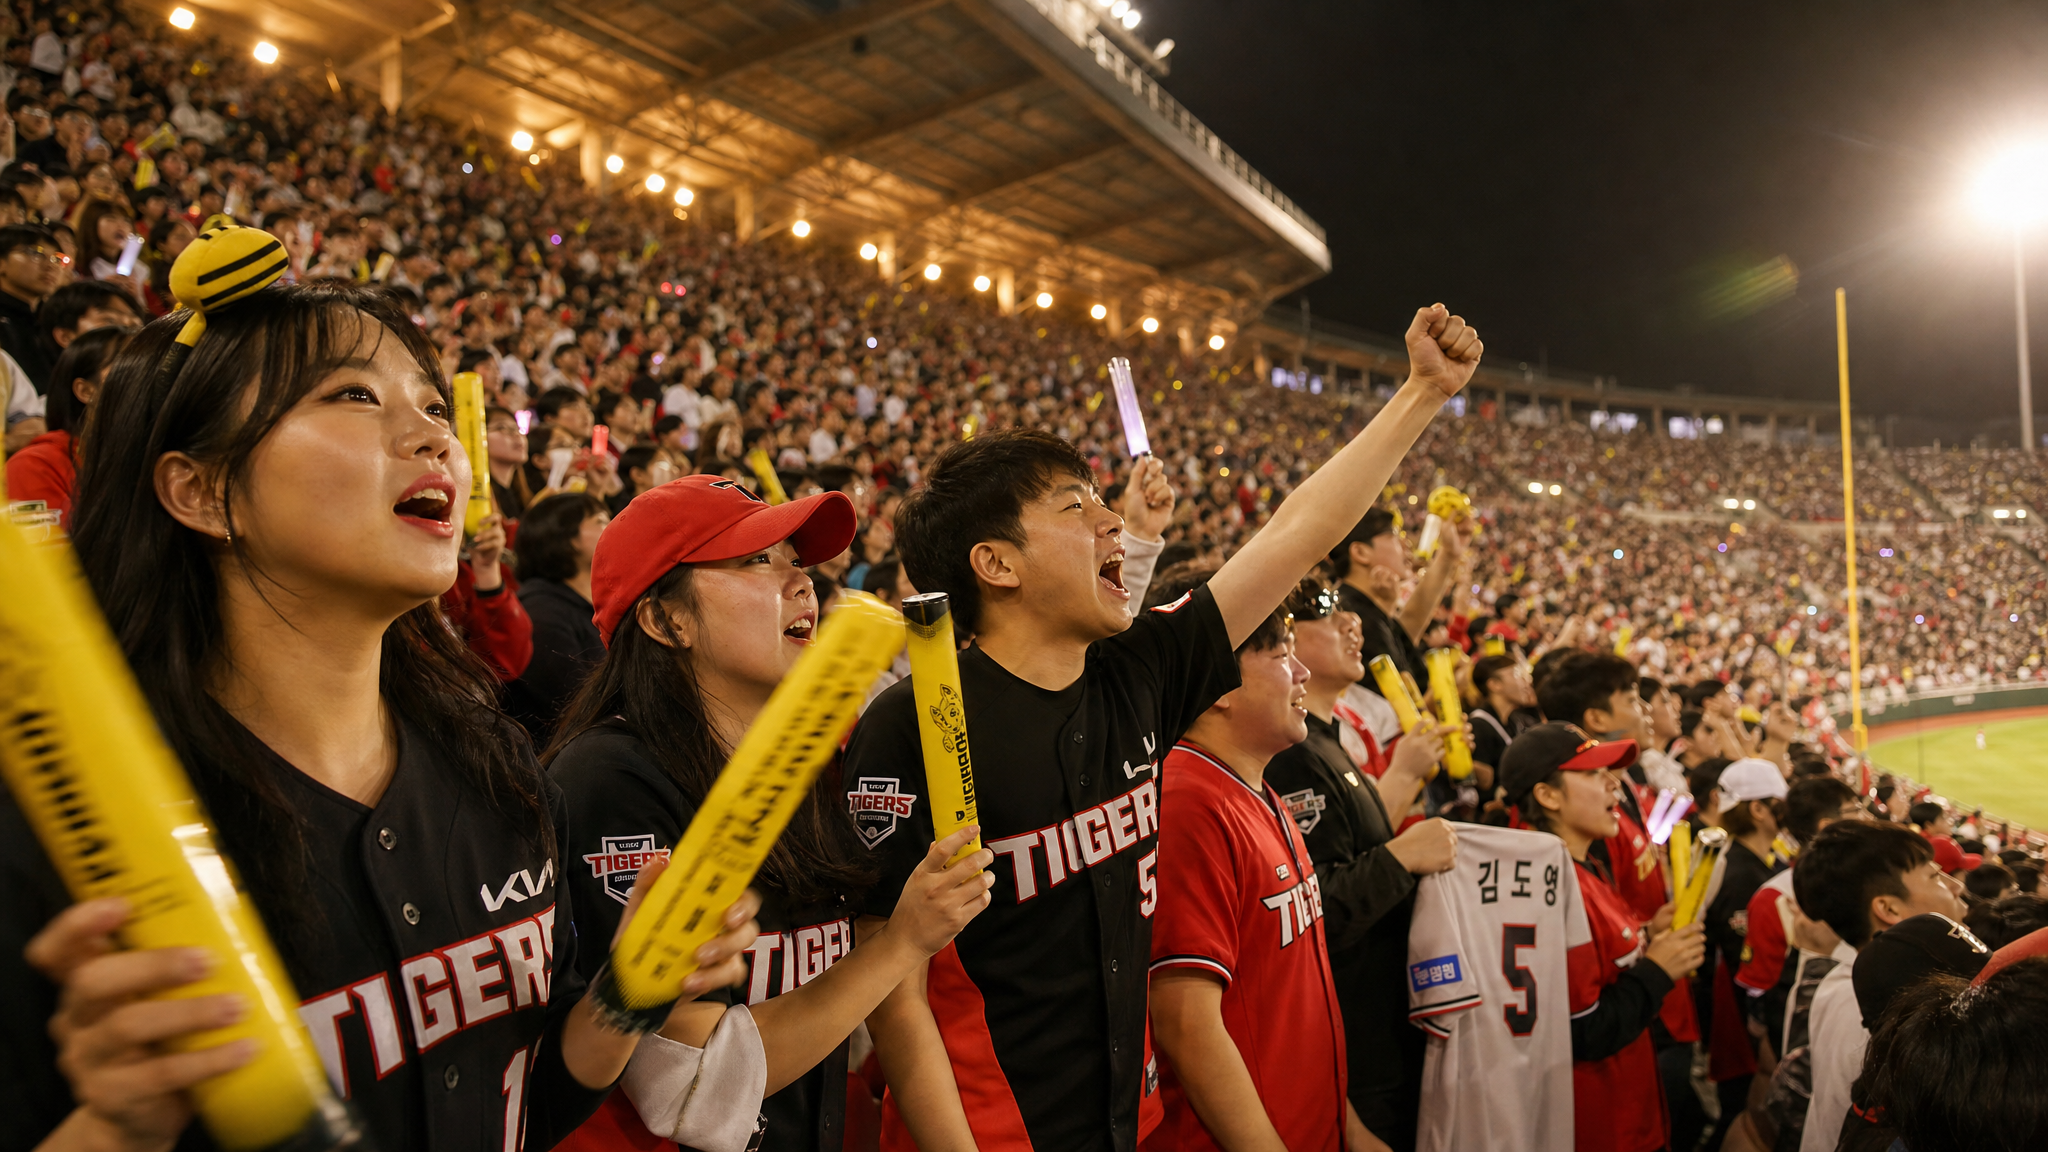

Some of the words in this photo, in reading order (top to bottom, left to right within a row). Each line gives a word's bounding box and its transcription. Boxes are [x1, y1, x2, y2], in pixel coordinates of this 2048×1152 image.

[847, 793, 917, 818] TIGERS
[1478, 859, 1559, 907] 김도영
[1502, 922, 1538, 1037] 5
[501, 1043, 531, 1152] 1
